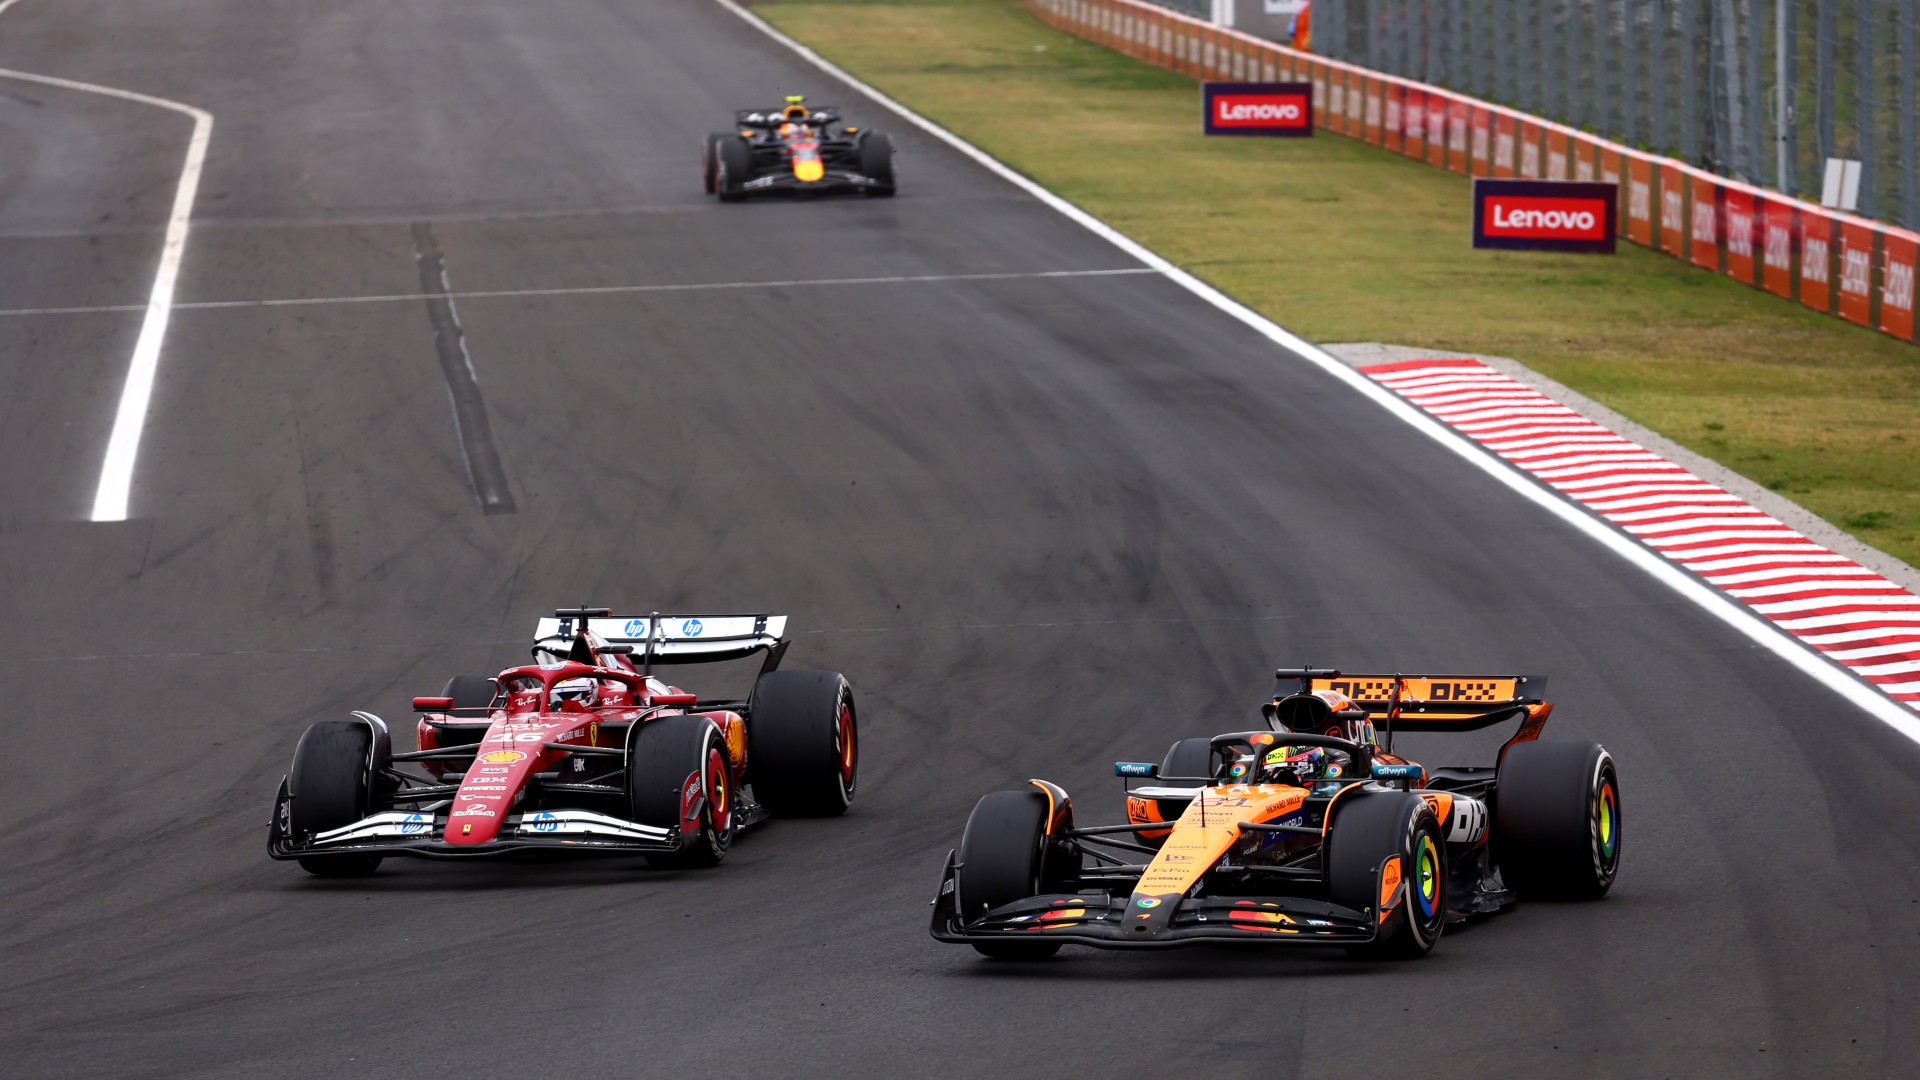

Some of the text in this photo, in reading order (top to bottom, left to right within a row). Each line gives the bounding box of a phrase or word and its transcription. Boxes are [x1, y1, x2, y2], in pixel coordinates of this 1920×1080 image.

[1220, 101, 1300, 120] Lenovo
[1493, 204, 1595, 231] Lenovo
[625, 619, 645, 638] hp
[683, 619, 703, 638] hp
[1430, 682, 1497, 700] OKX
[488, 732, 544, 742] 16
[1121, 764, 1146, 775] allwyn
[1378, 766, 1407, 776] allwyn
